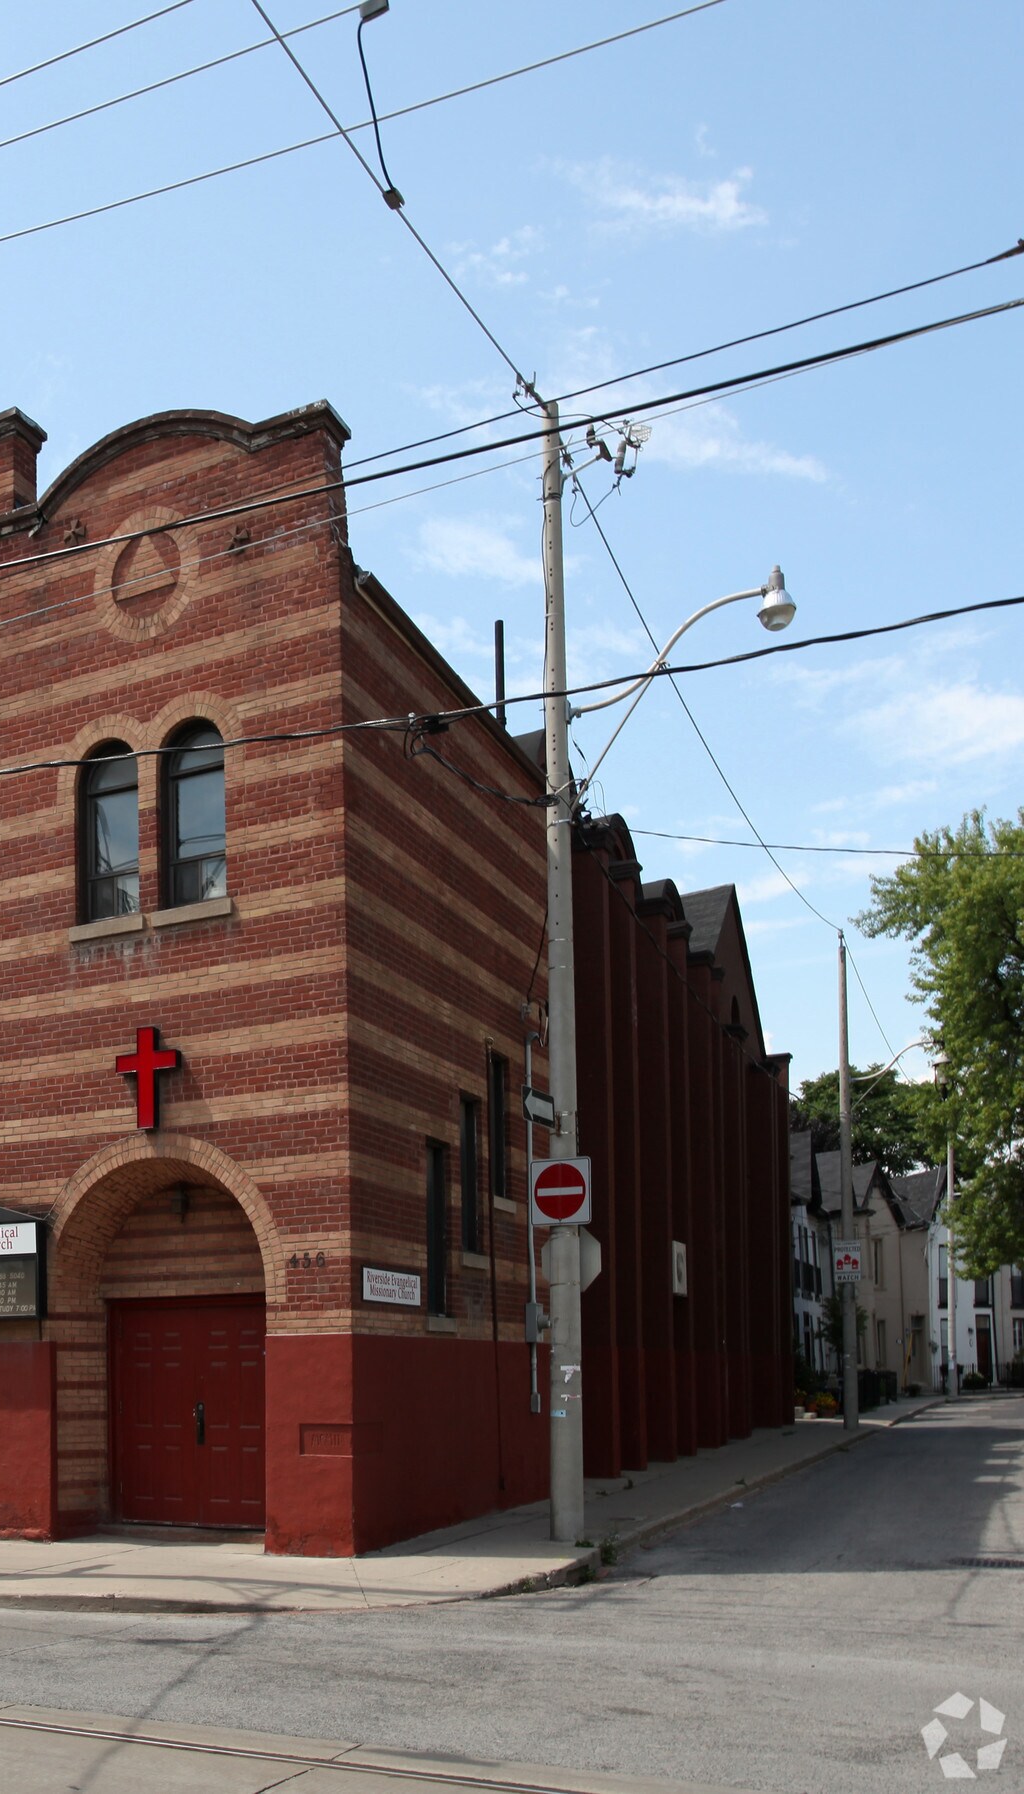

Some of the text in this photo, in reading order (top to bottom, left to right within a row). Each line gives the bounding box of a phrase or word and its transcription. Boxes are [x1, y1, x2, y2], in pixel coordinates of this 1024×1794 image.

[289, 1251, 326, 1268] 456
[366, 1270, 418, 1290] Riverside Evangelical
[369, 1284, 416, 1300] Missionary Church
